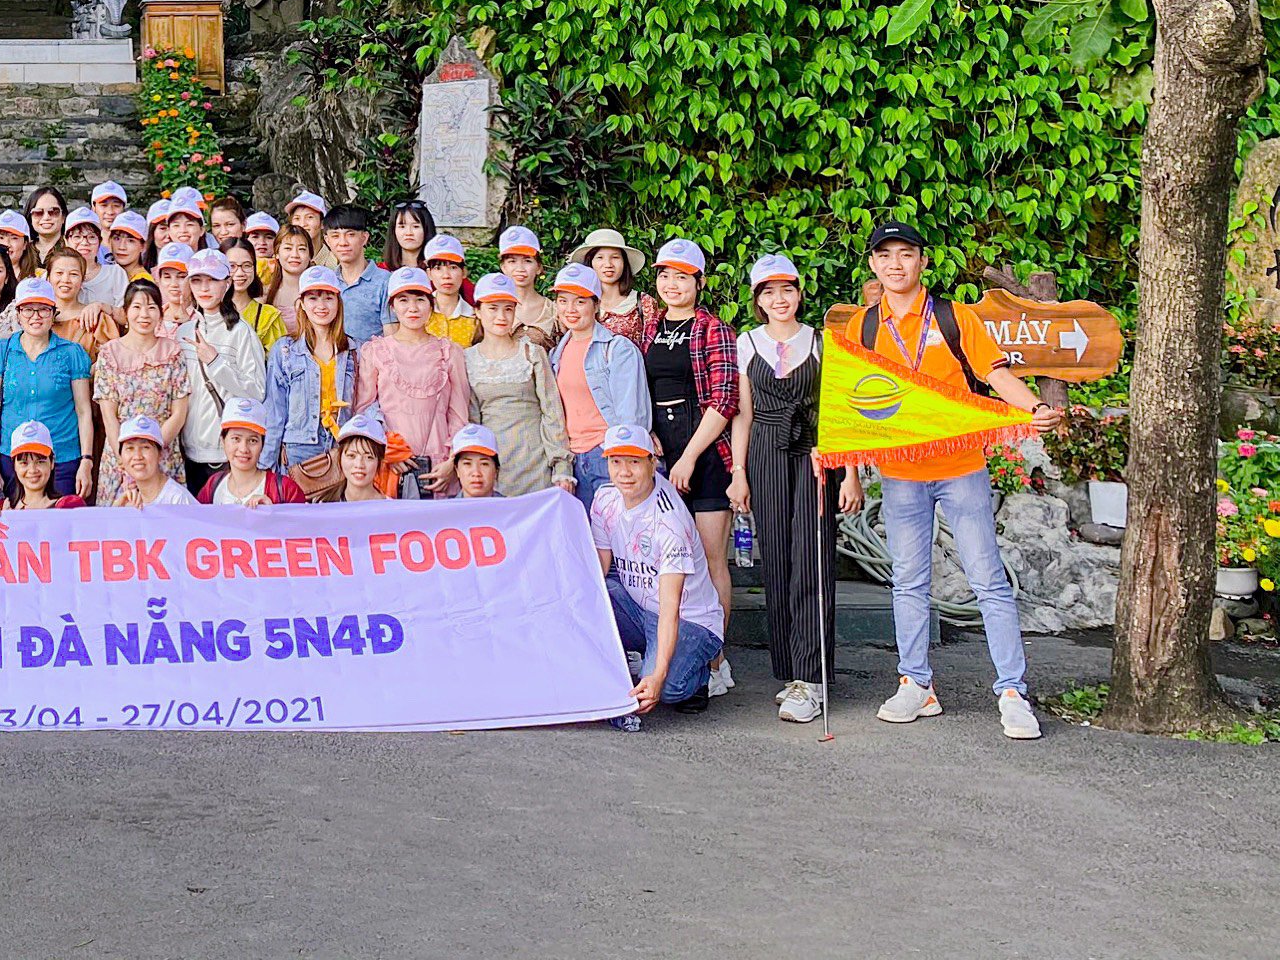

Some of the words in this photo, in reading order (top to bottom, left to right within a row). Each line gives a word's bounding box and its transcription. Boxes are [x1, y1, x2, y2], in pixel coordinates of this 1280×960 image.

[983, 312, 1052, 345] MÁY
[68, 538, 171, 583] TBK
[185, 536, 353, 580] GREEN
[369, 526, 507, 574] FOOD
[17, 613, 93, 668] ĐÀ
[104, 596, 252, 666] NẴNG
[263, 613, 405, 659] 5N4Đ
[121, 696, 326, 728] 27/04/2021
